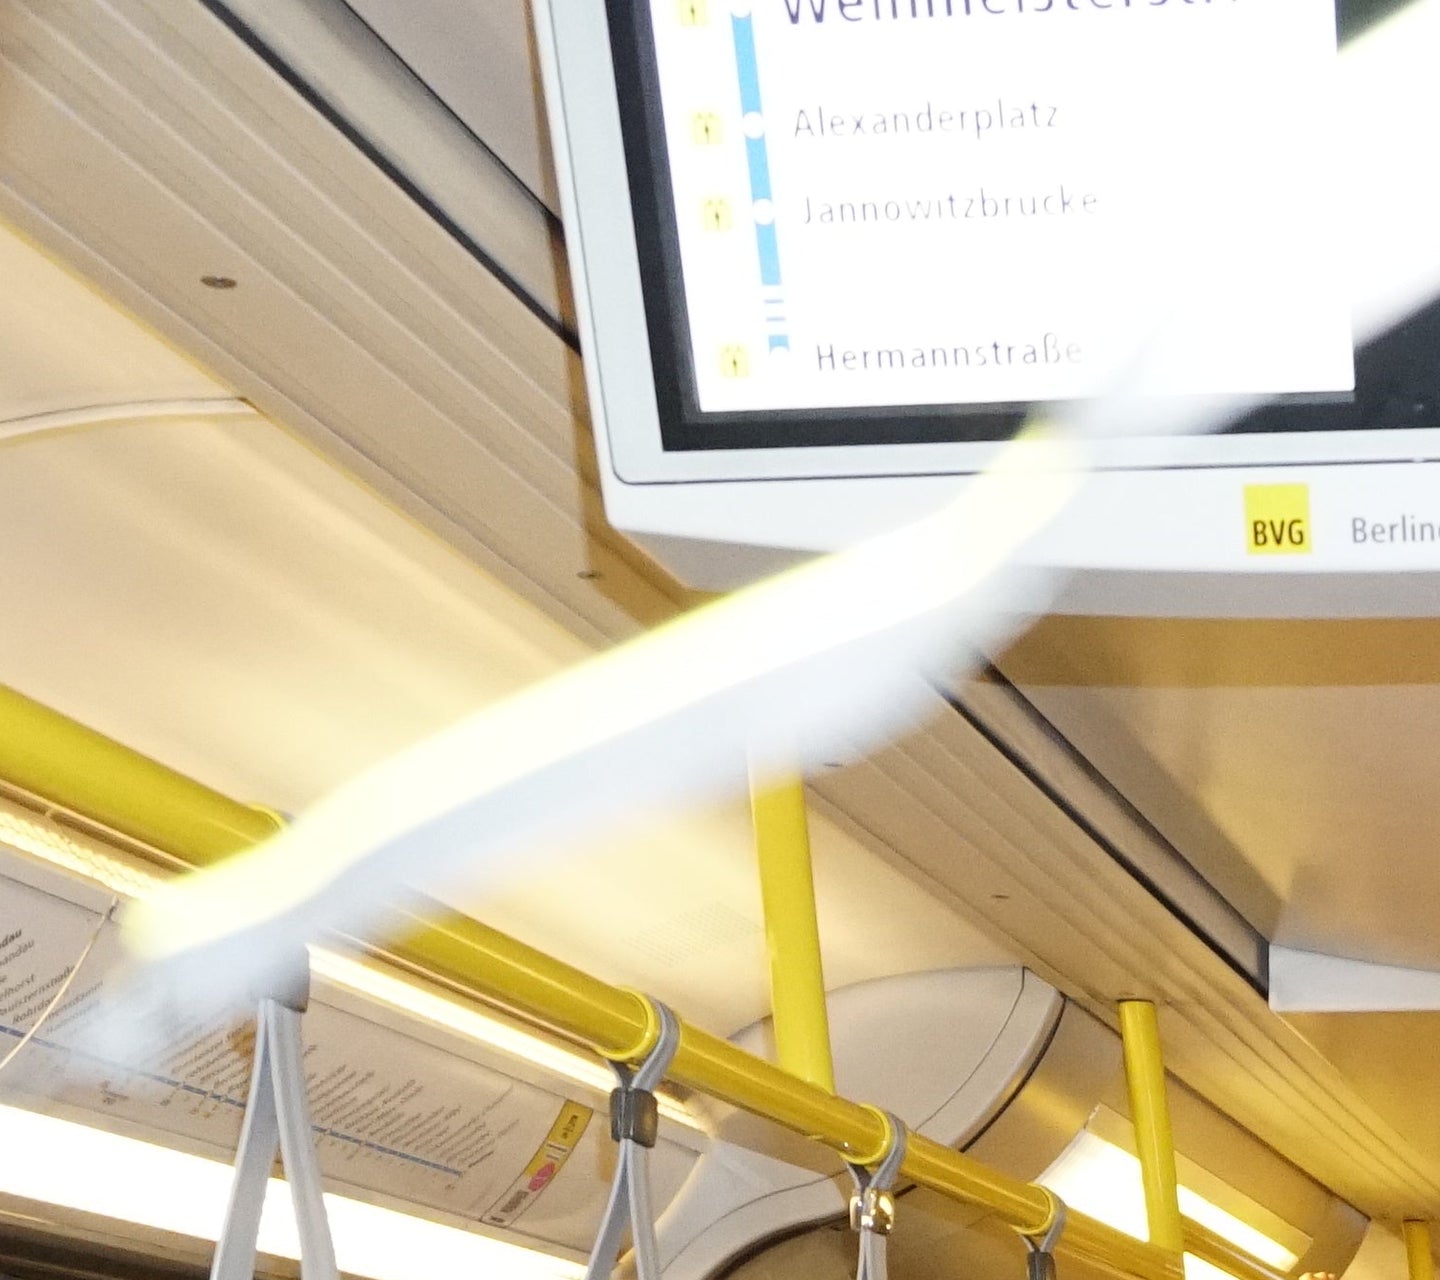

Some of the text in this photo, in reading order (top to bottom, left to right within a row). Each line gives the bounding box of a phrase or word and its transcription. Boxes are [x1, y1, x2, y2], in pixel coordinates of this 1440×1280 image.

[794, 98, 1058, 140] Alexanderplatz
[816, 332, 1083, 371] Hermannstraße
[1253, 518, 1305, 546] BVG
